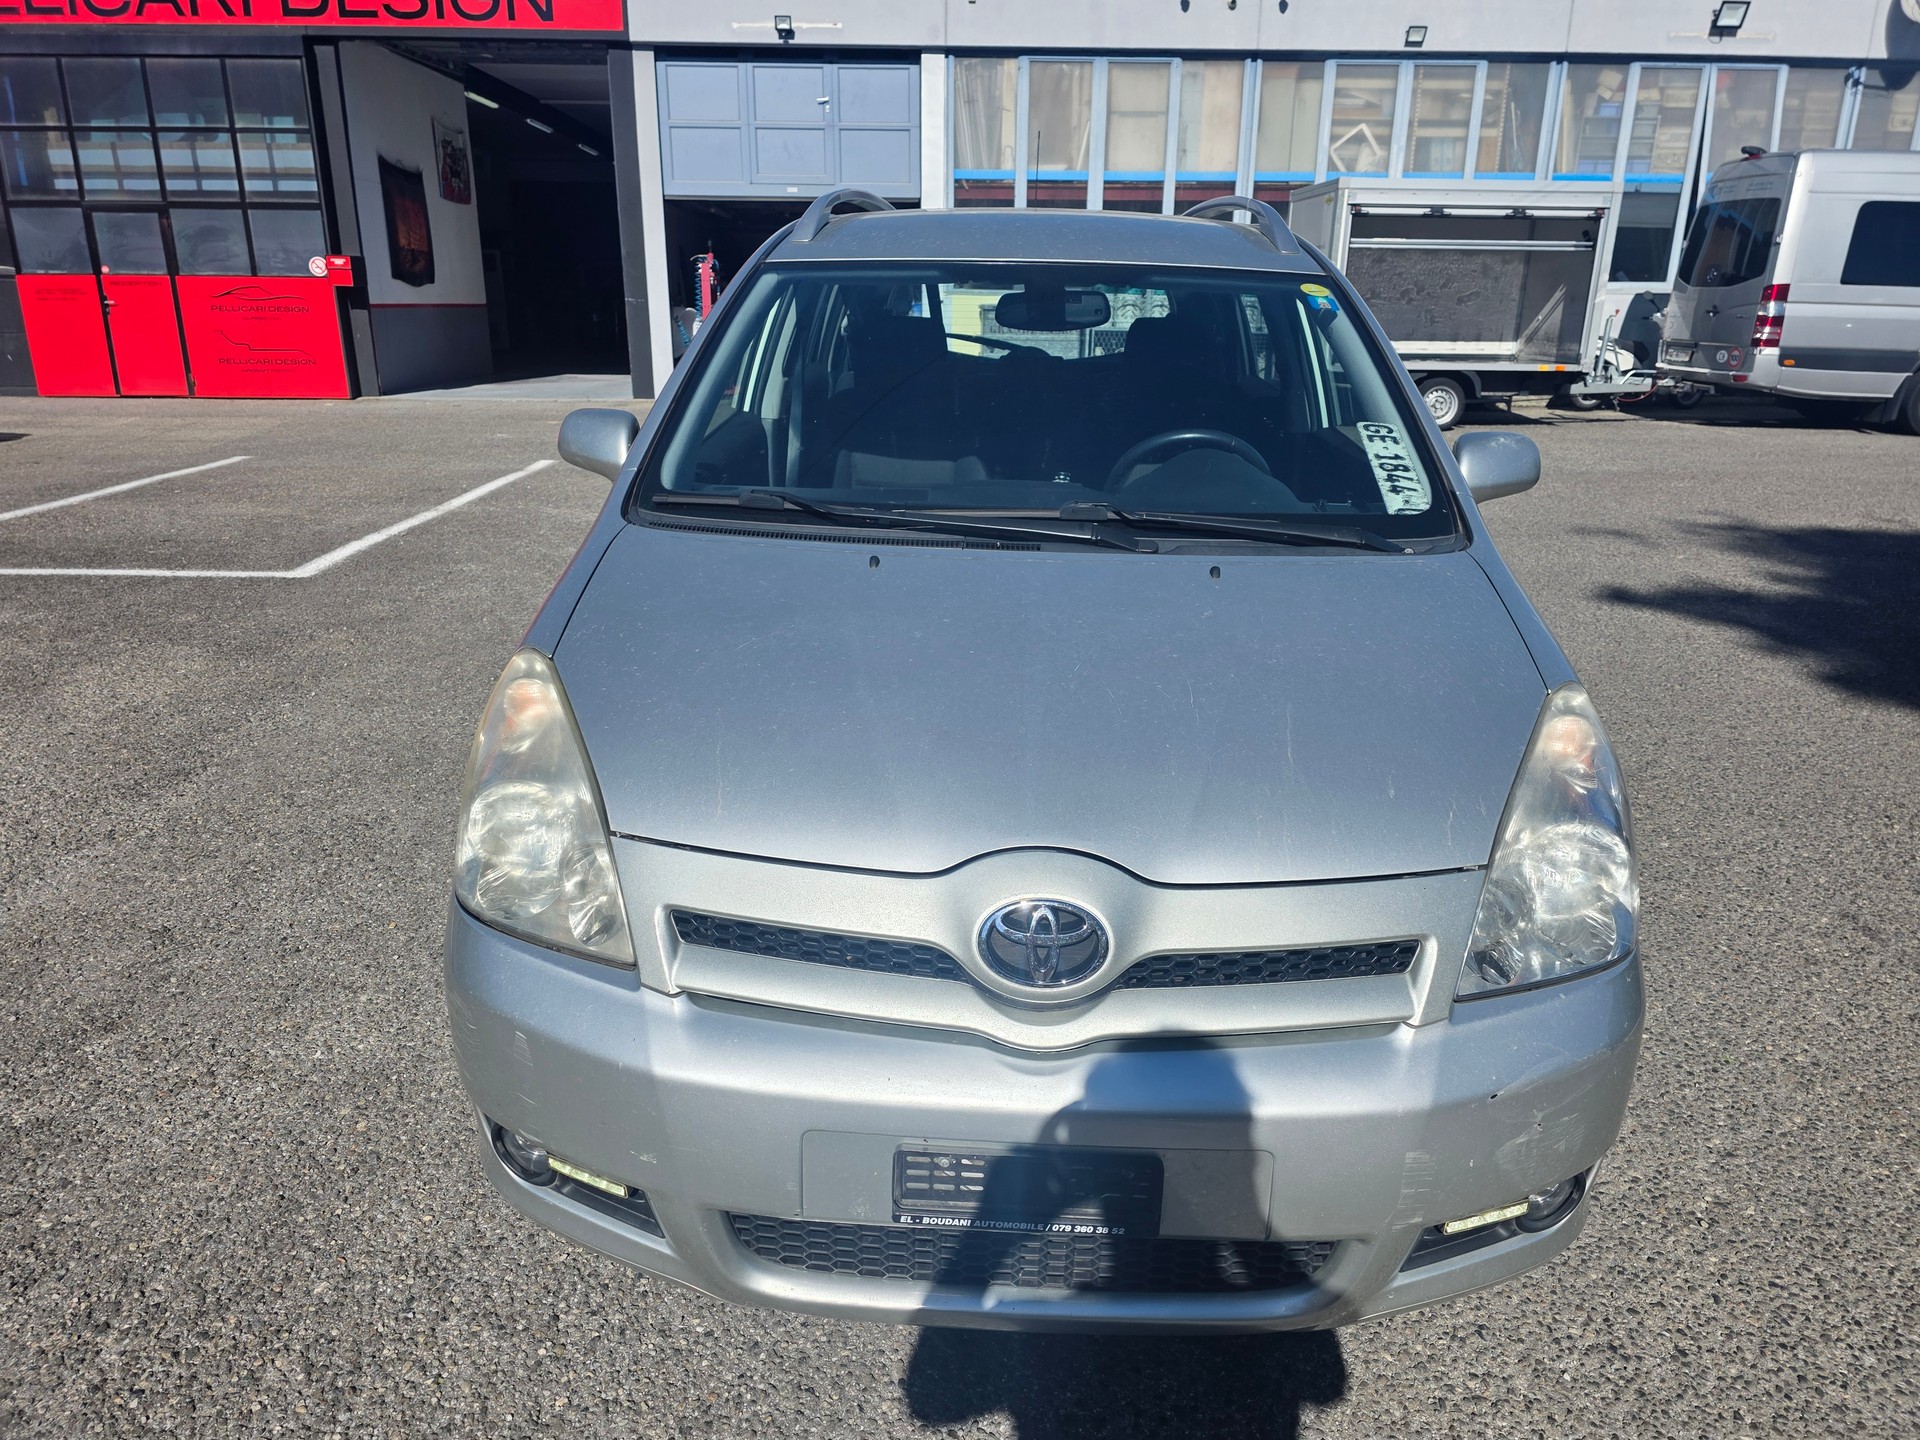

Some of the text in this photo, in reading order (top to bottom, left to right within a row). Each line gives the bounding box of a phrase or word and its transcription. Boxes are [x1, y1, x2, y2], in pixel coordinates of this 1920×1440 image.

[268, 305, 310, 313] DESIGN
[922, 1217, 972, 1227] BOUDANI
[973, 1220, 1044, 1231] AUTOMOBILE
[1052, 1224, 1072, 1232] 079
[1073, 1225, 1094, 1234] 360
[1095, 1226, 1109, 1234] 38
[1111, 1227, 1125, 1235] 52
